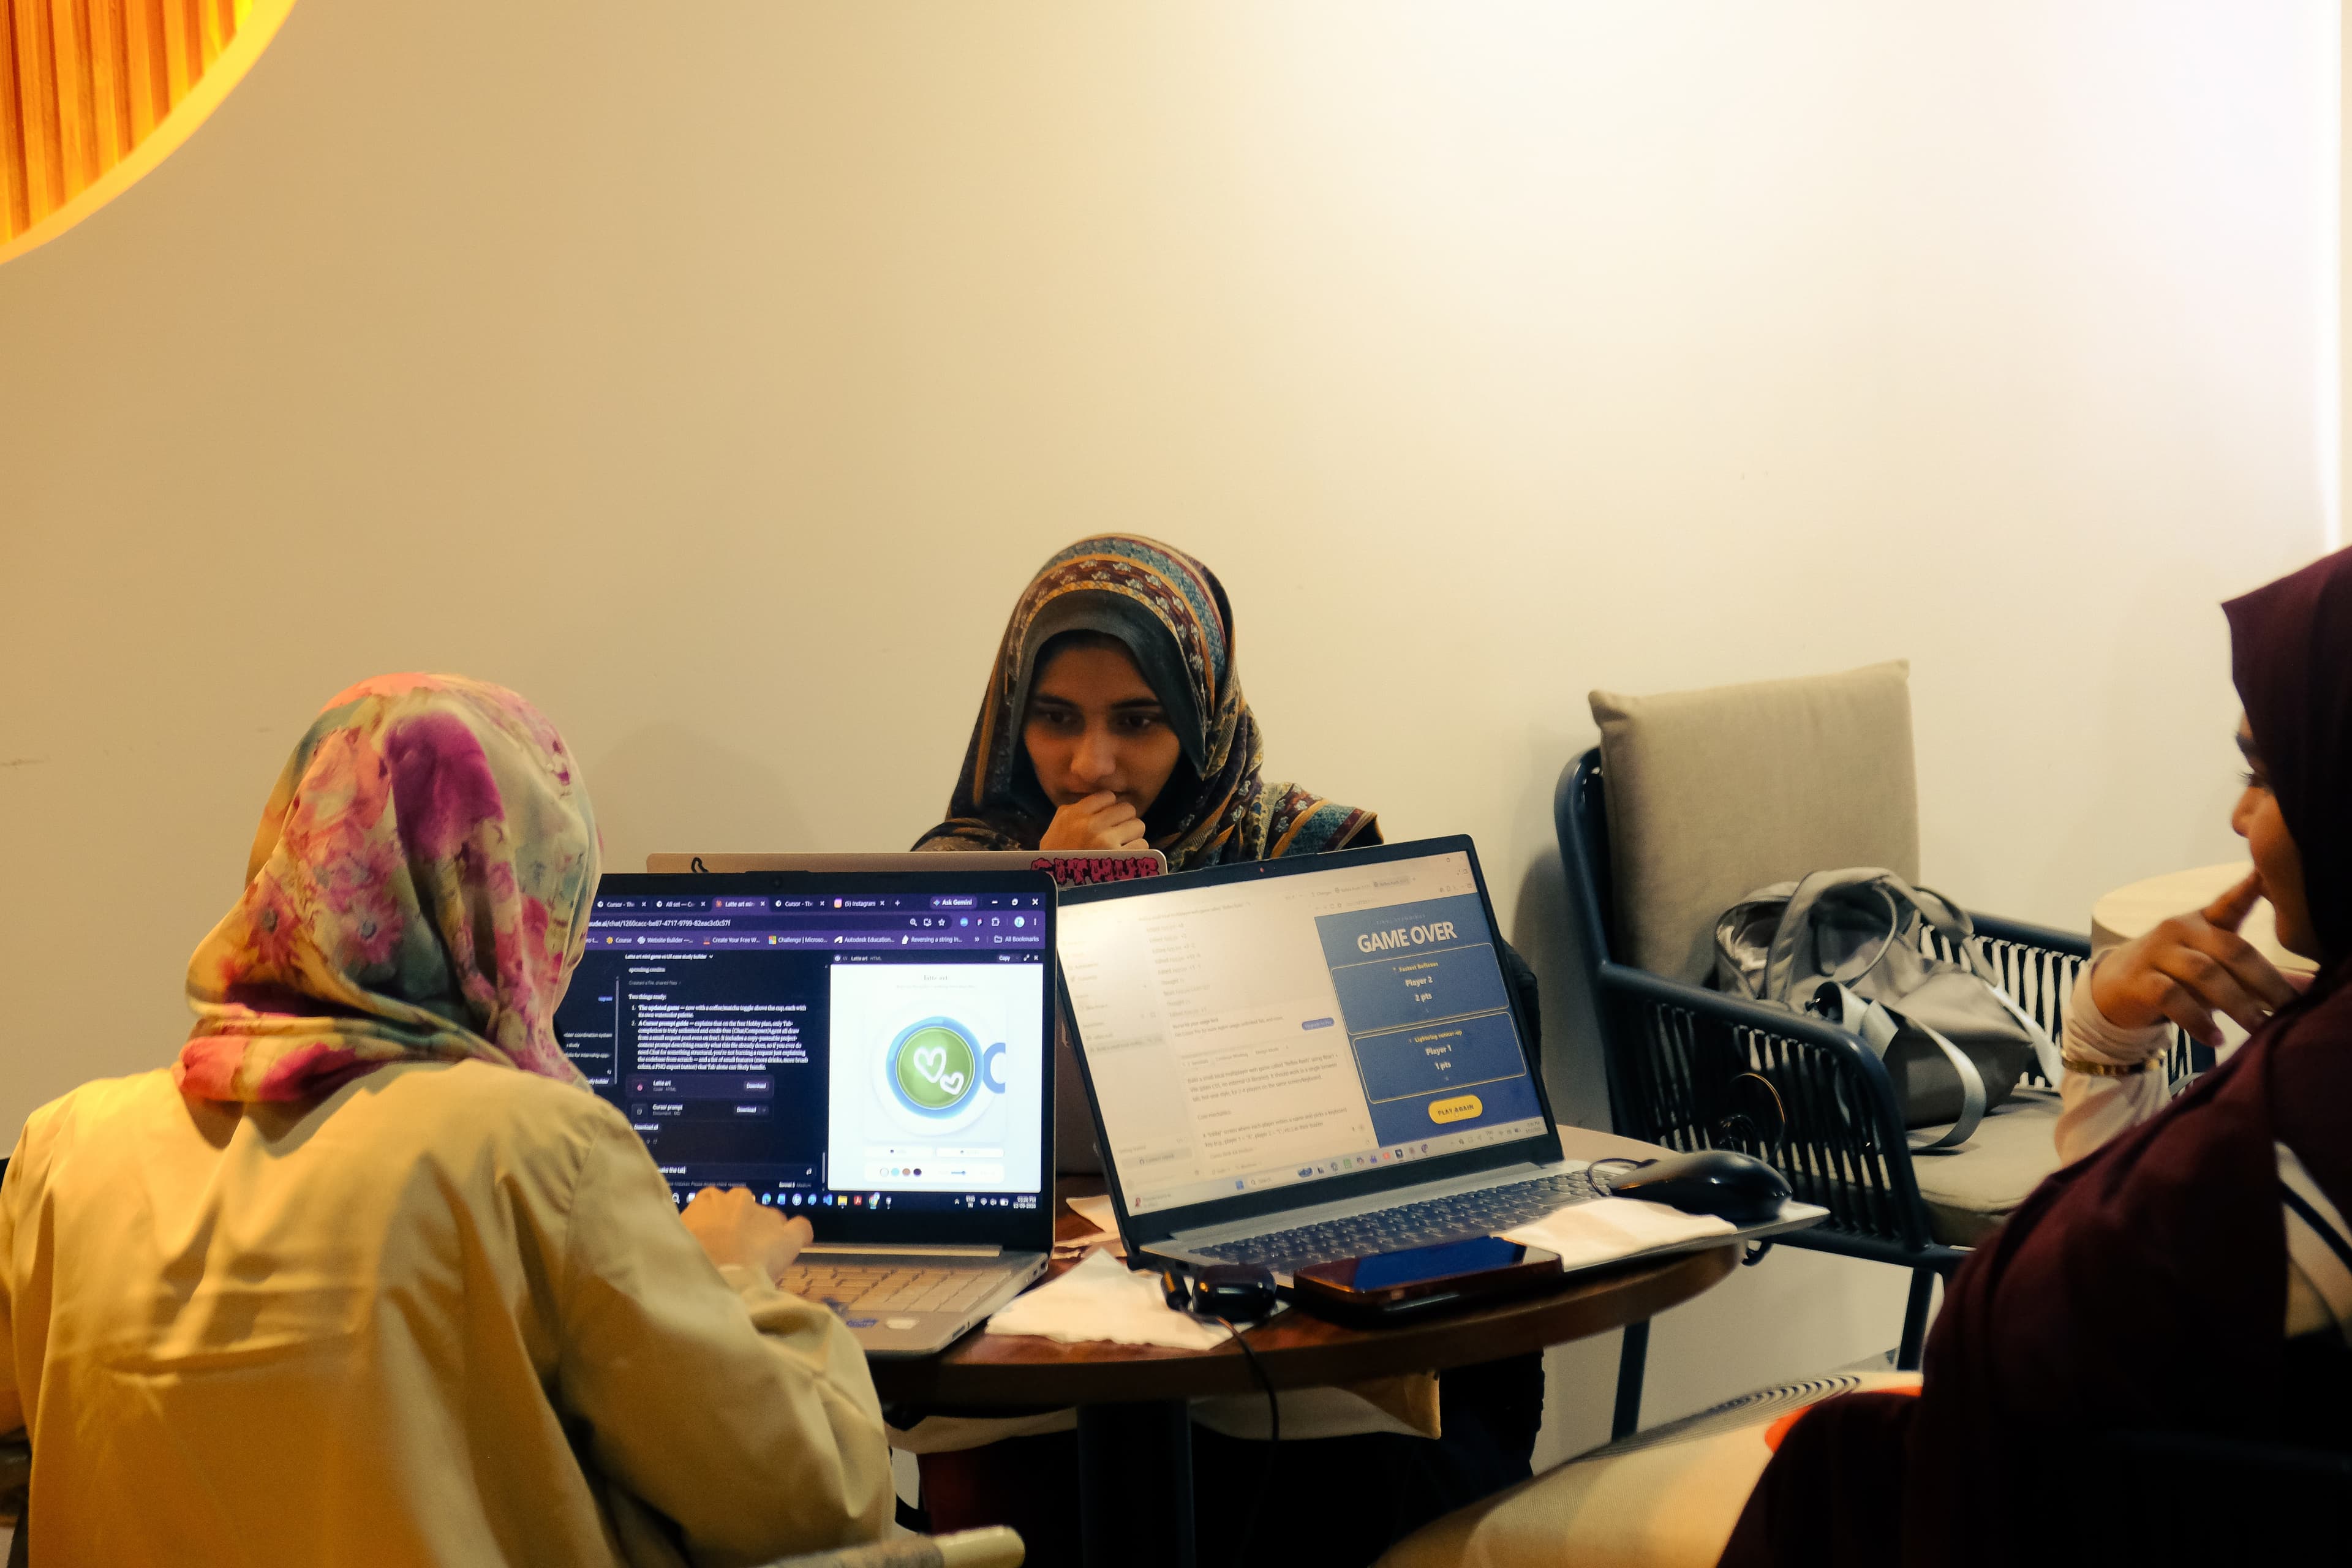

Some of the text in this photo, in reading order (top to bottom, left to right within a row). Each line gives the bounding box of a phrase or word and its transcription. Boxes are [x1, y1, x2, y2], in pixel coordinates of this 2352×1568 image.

[1357, 921, 1458, 953] GAME OVER
[1405, 978, 1427, 987] Player
[1421, 992, 1432, 1002] pts
[1415, 1035, 1438, 1043] Lightning
[1425, 1047, 1447, 1056] Player
[1440, 1062, 1452, 1071] pts
